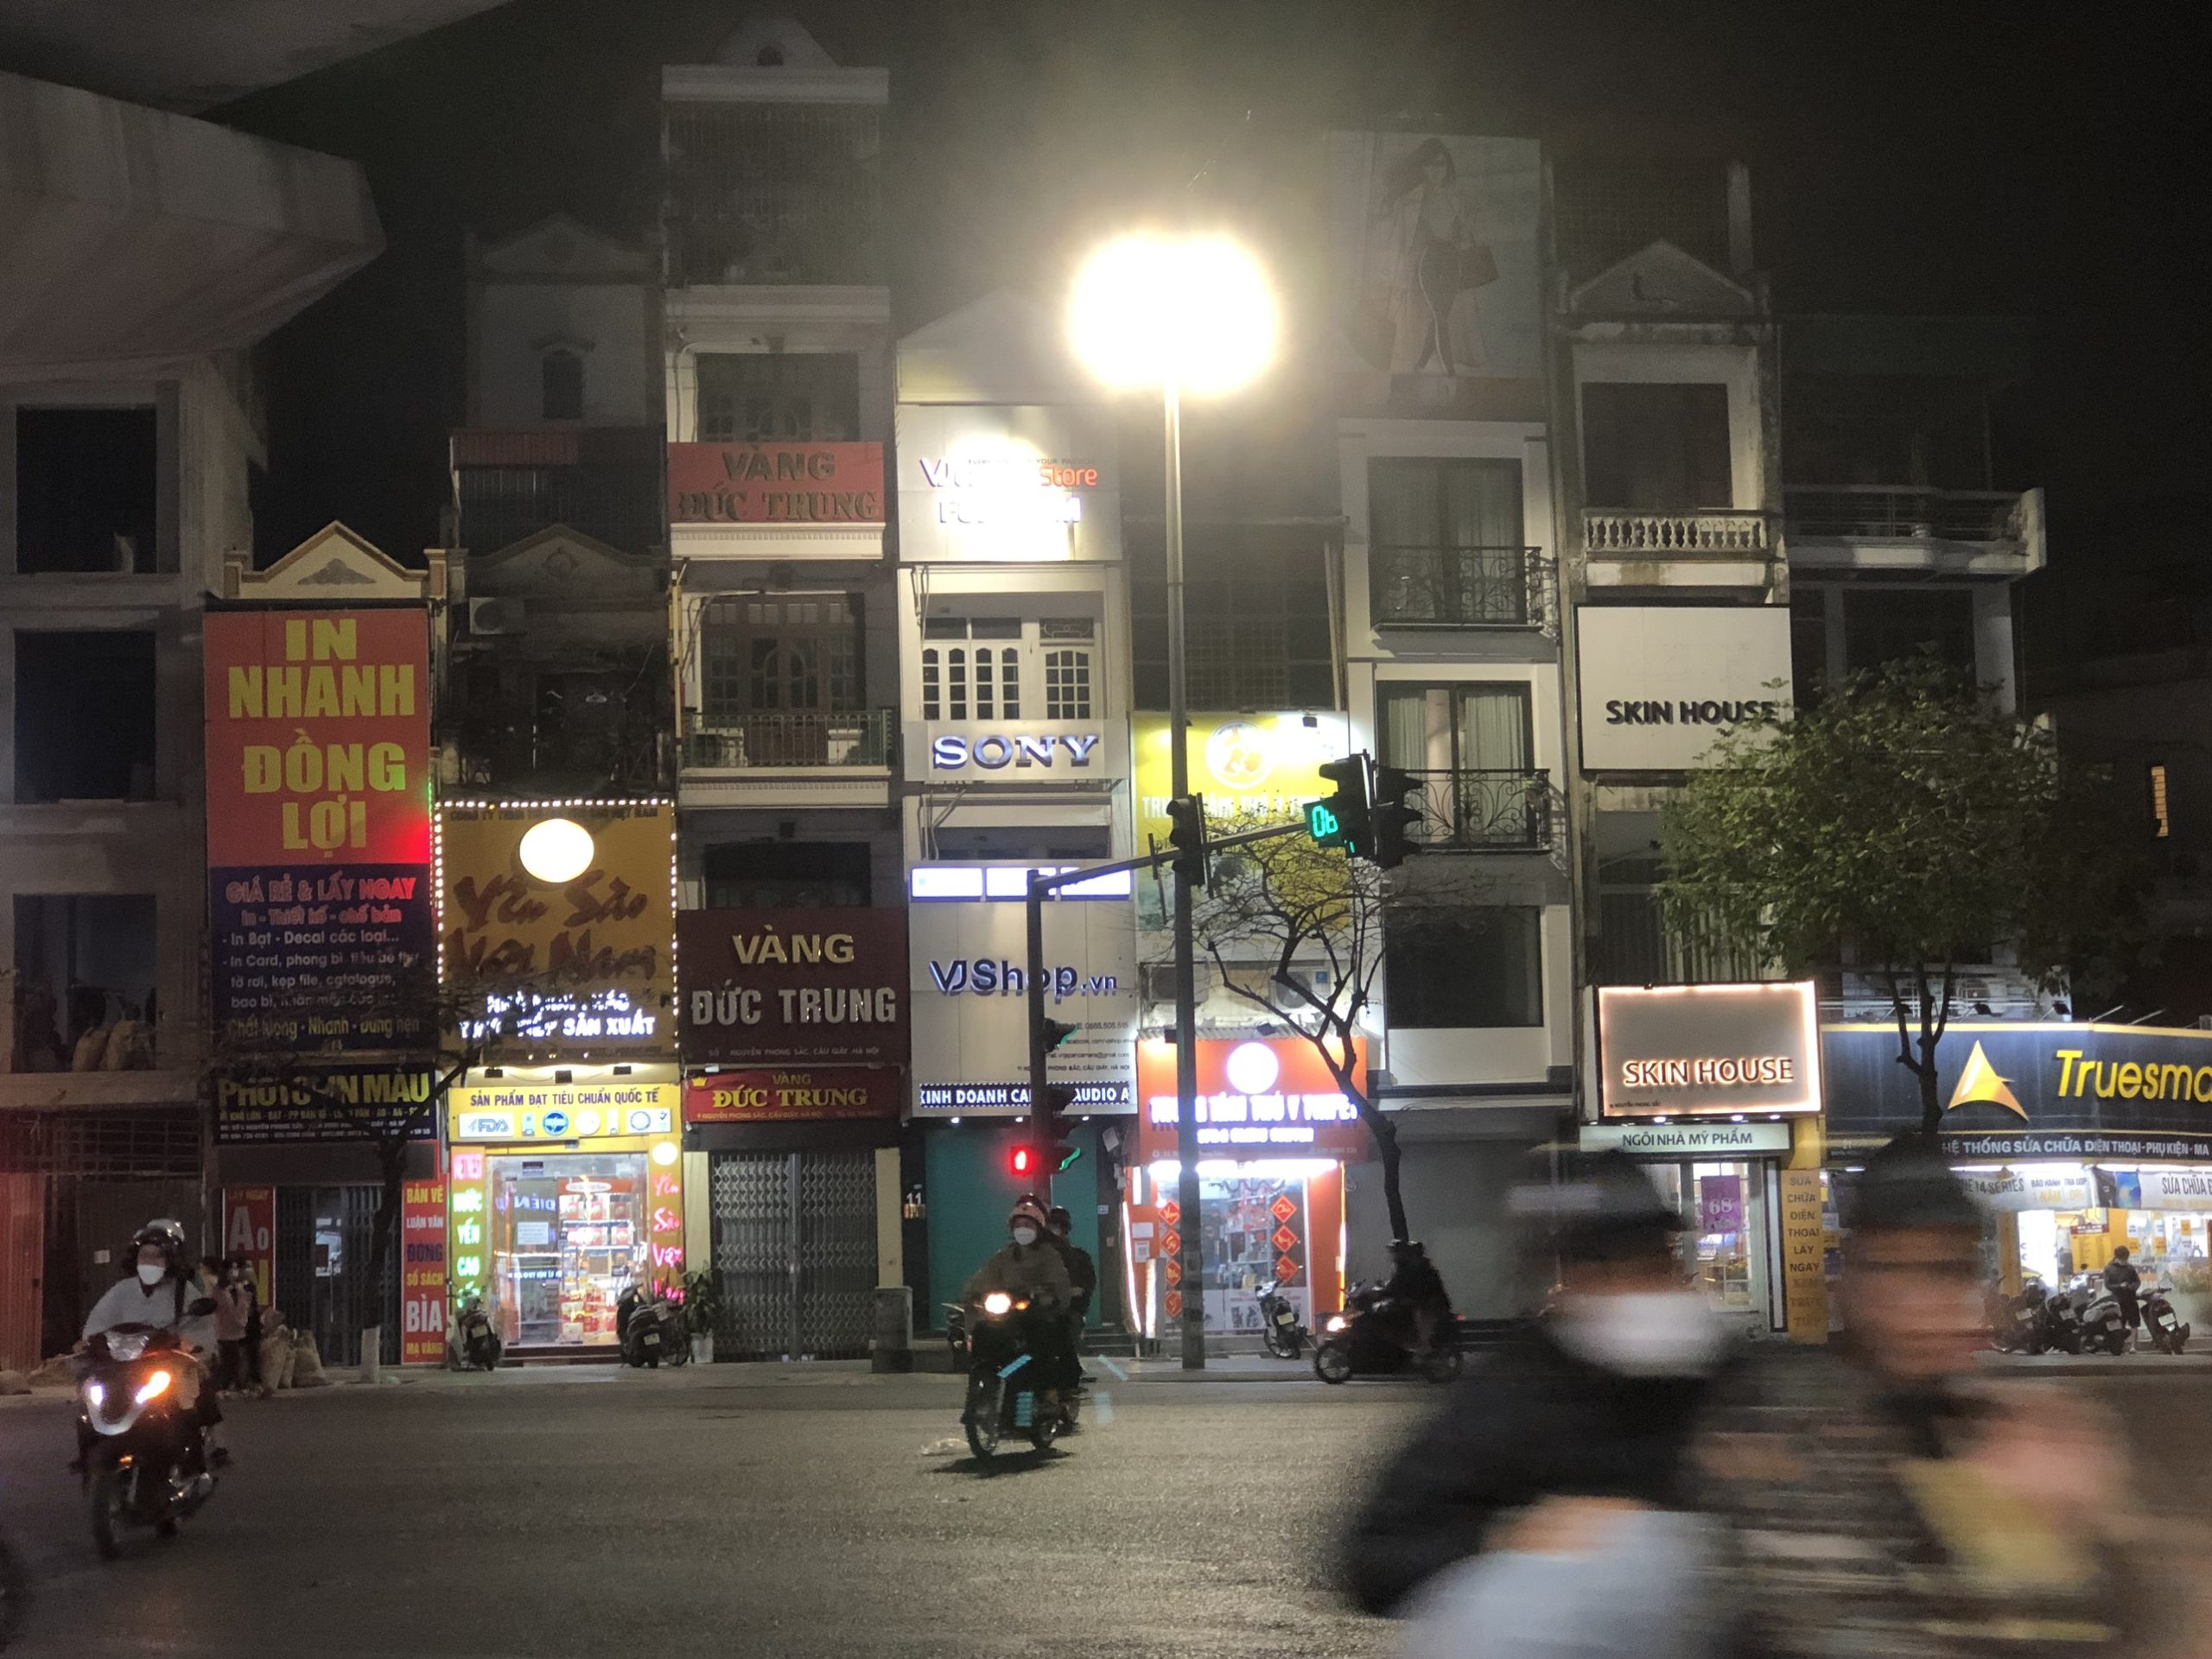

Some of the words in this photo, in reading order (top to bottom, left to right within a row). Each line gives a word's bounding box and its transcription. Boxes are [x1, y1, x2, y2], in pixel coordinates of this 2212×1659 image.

[722, 446, 836, 481] VÀNG
[1040, 465, 1097, 486] Store
[762, 491, 879, 520] TRUNG
[286, 619, 356, 661] IN
[229, 664, 415, 719] NHANH
[1605, 700, 1674, 725] SKIN
[1680, 701, 1778, 724] HOUSE
[241, 728, 406, 793] ĐỒNG
[932, 735, 1098, 769] SONY
[283, 794, 366, 858] LỢI
[226, 874, 264, 904] GIÁ
[269, 873, 292, 902] RẺ
[297, 880, 313, 901] &
[317, 870, 355, 900] LẤY
[359, 877, 416, 900] NGAY
[231, 933, 244, 946] In
[248, 931, 271, 949] Bạt
[283, 931, 325, 944] Decal
[329, 929, 356, 944] các
[733, 924, 854, 964] VÀNG
[230, 955, 242, 967] In
[286, 953, 327, 968] phong
[691, 979, 761, 1025] ĐỨC
[779, 987, 896, 1024] TRUNG
[772, 1071, 812, 1085] VÀNG
[1623, 1059, 1688, 1086] SKIN
[1696, 1057, 1795, 1084] HOUSE
[471, 1090, 490, 1106] SẢN
[529, 1093, 547, 1108] ĐẠT
[578, 1087, 610, 1103] CHUẨN
[614, 1088, 642, 1103] QUỐC
[645, 1087, 660, 1103] TẾ
[712, 1084, 768, 1109] ĐỨC
[776, 1088, 868, 1107] TRUNG
[956, 1089, 1007, 1103] DOANH
[1073, 1087, 1116, 1102] AUDIO
[1623, 1131, 1654, 1147] NGÔI
[1657, 1129, 1685, 1146] NHÀ
[1713, 1127, 1753, 1144] PHẨM
[1963, 1136, 2012, 1154] THỐNG
[2014, 1135, 2040, 1154] SỬA
[2044, 1136, 2081, 1154] CHỮA
[2085, 1140, 2109, 1154] ĐIỆN
[2111, 1141, 2139, 1156] THOẠI
[407, 1183, 428, 1204] BẢN
[1988, 1179, 2024, 1195] SERIES
[421, 1270, 443, 1286] SÁCH
[1790, 1262, 1820, 1272] NGAY
[406, 1294, 442, 1332] BÌA
